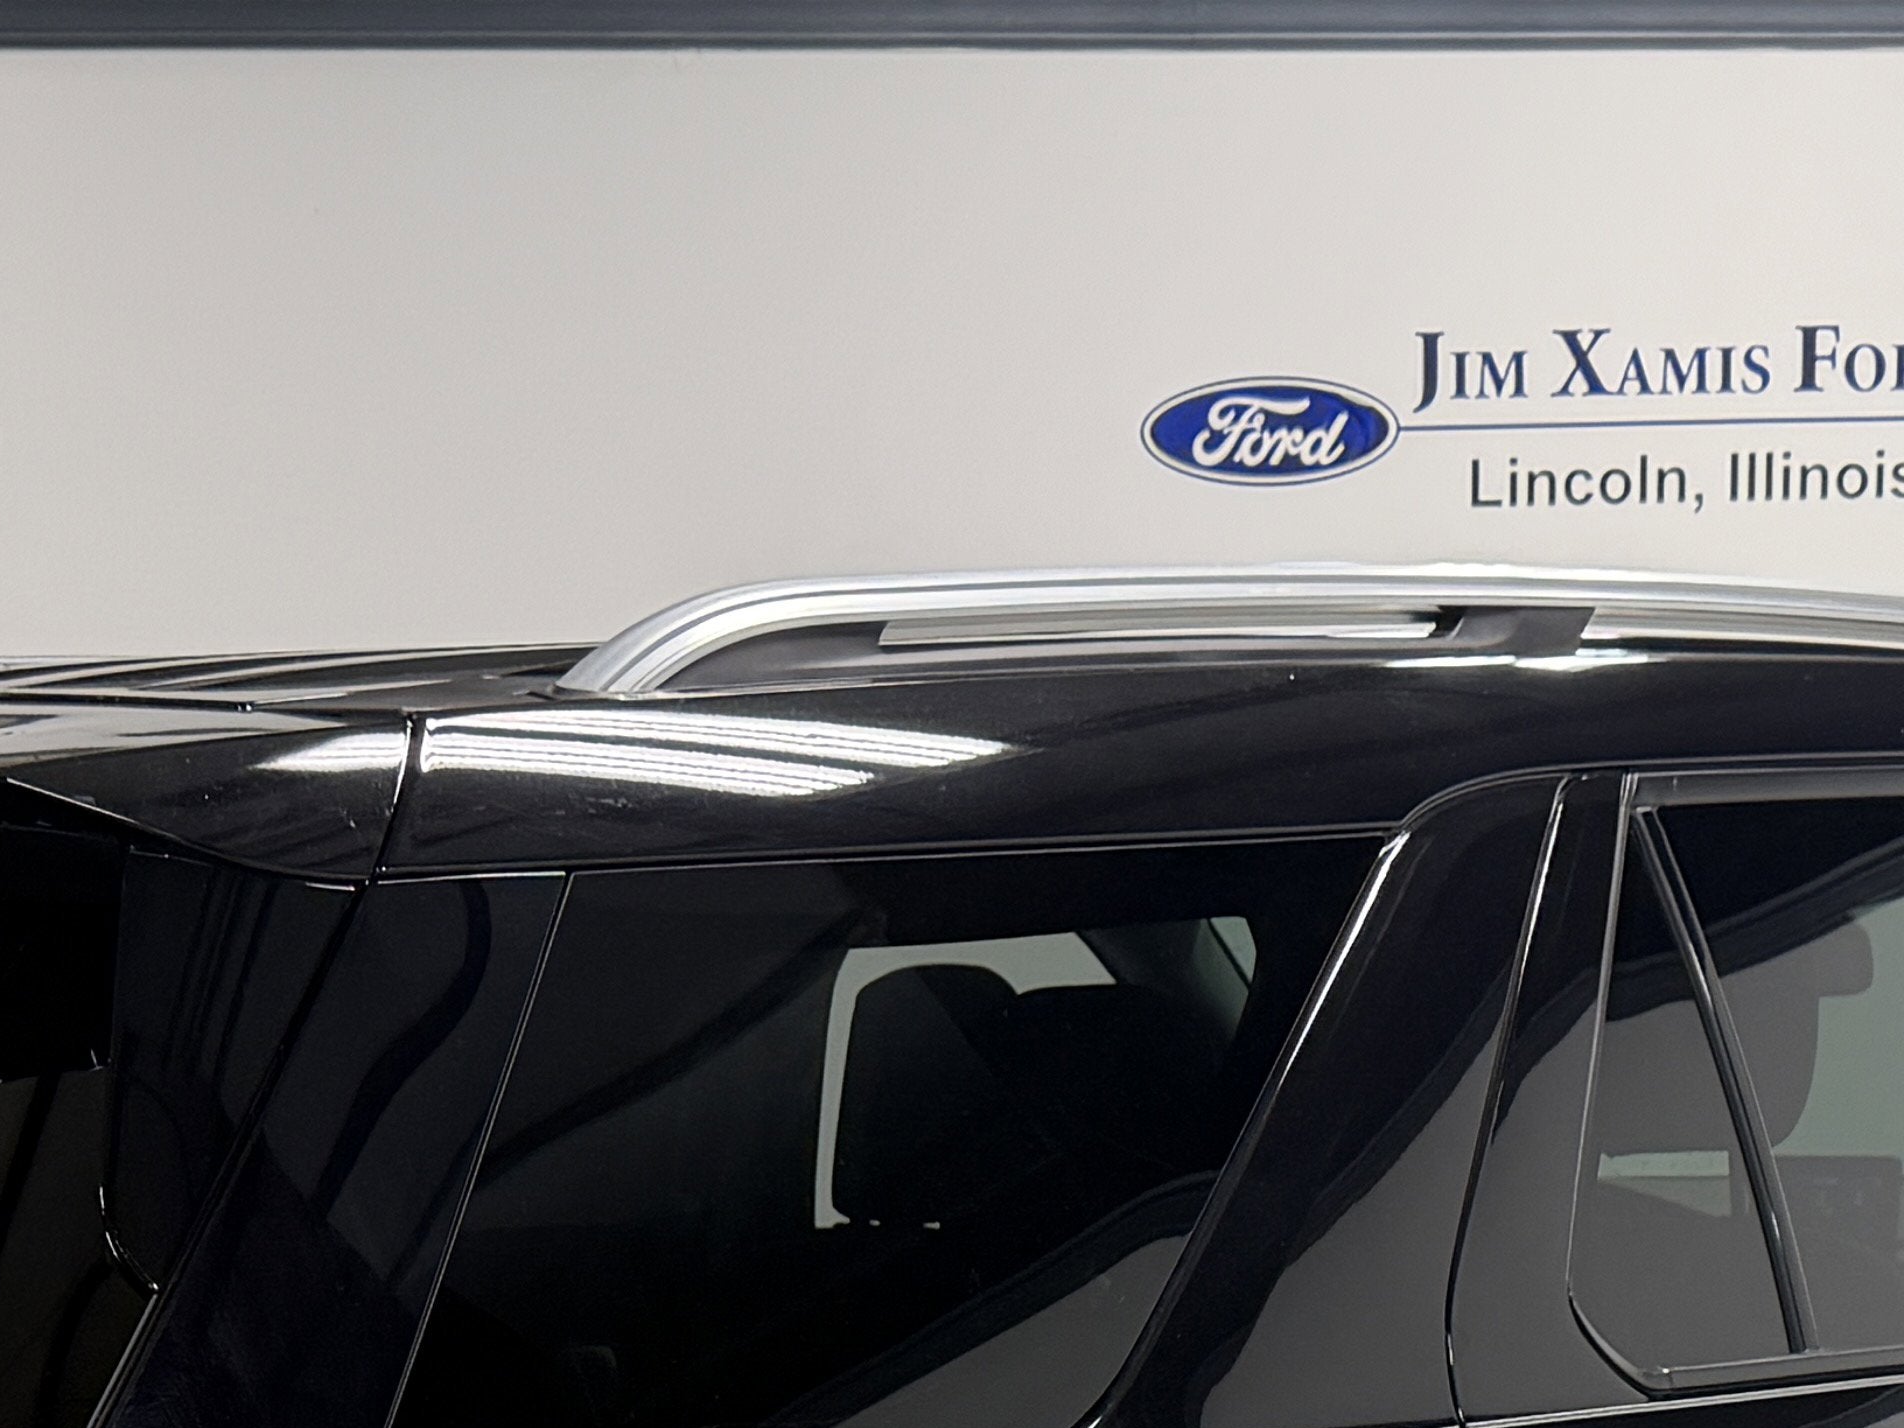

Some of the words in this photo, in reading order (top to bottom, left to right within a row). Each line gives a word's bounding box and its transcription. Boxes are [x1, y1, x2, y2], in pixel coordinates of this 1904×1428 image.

[1412, 331, 1527, 413] JIM
[1550, 328, 1771, 398] XAMIS
[1192, 396, 1349, 468] Ford
[1471, 454, 1703, 514] Lincoln,
